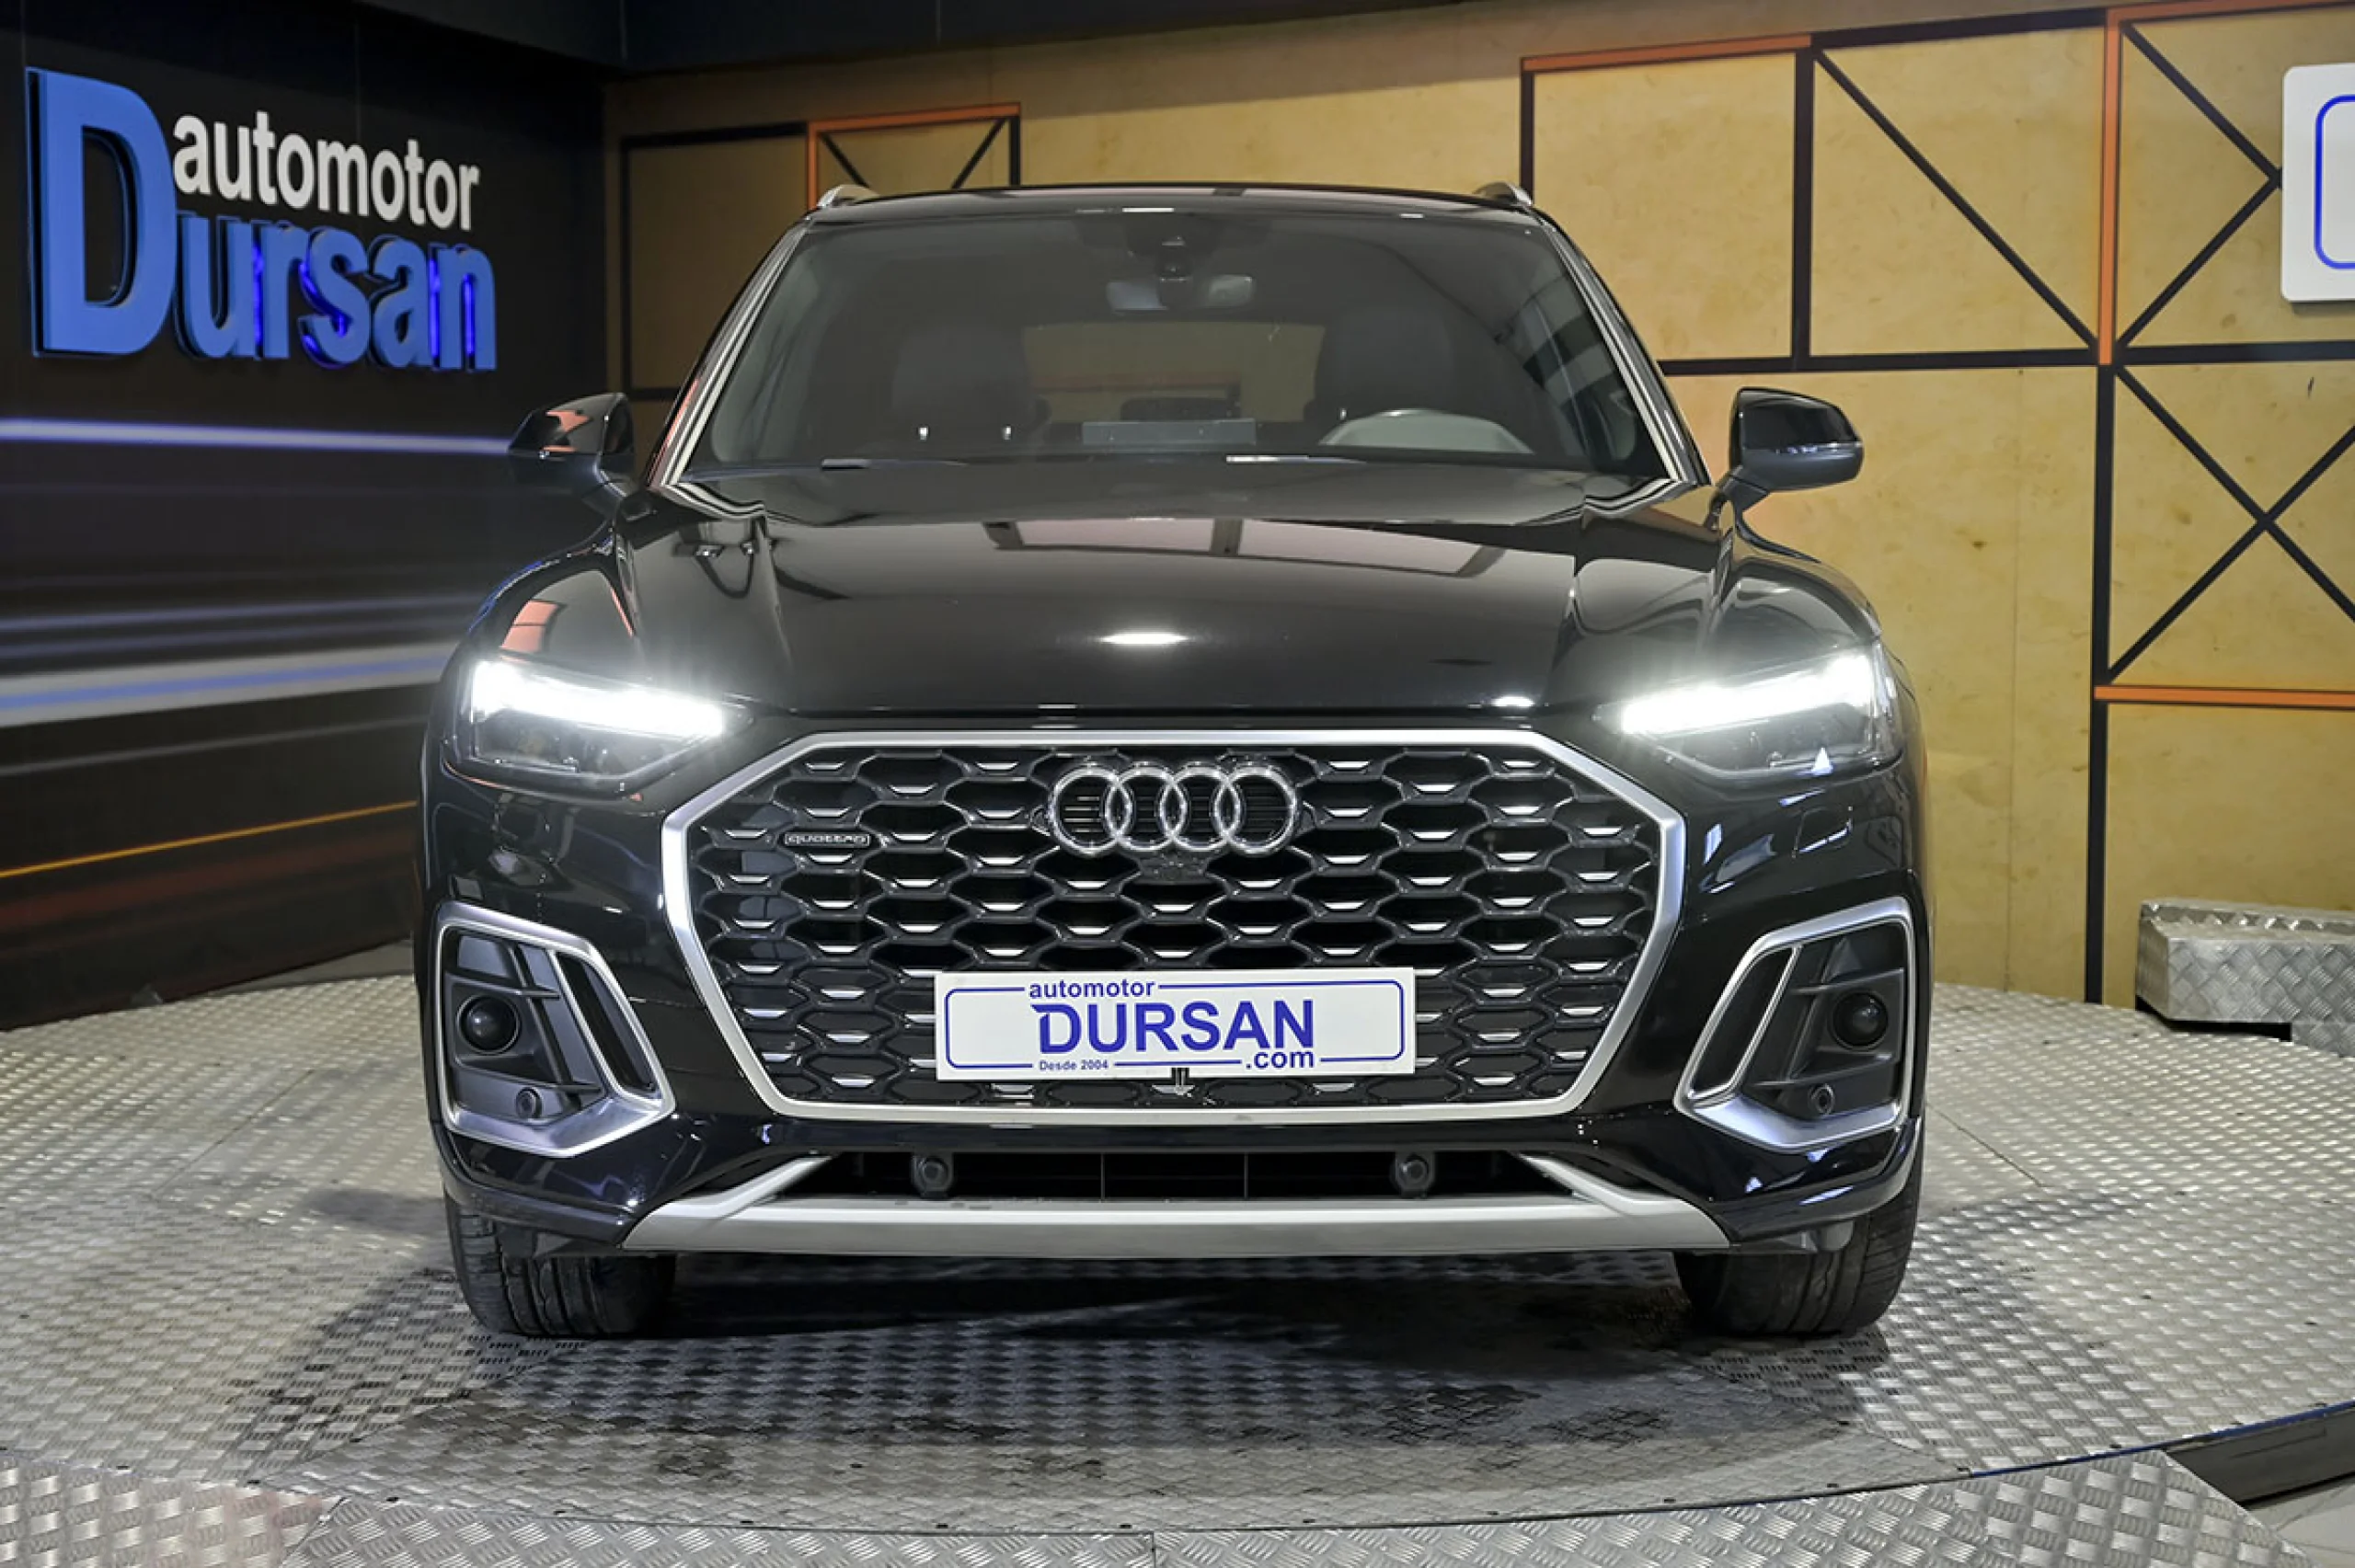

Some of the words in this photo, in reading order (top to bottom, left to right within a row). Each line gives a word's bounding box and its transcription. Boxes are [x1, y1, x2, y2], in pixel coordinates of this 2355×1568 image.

[173, 110, 480, 231] automotor
[26, 66, 498, 372] Dursan
[1029, 979, 1155, 998] automotor
[1030, 999, 1314, 1054] DURSAN
[1039, 1059, 1076, 1070] Desde
[1080, 1059, 1109, 1070] 2004
[1246, 1050, 1315, 1069] .com
